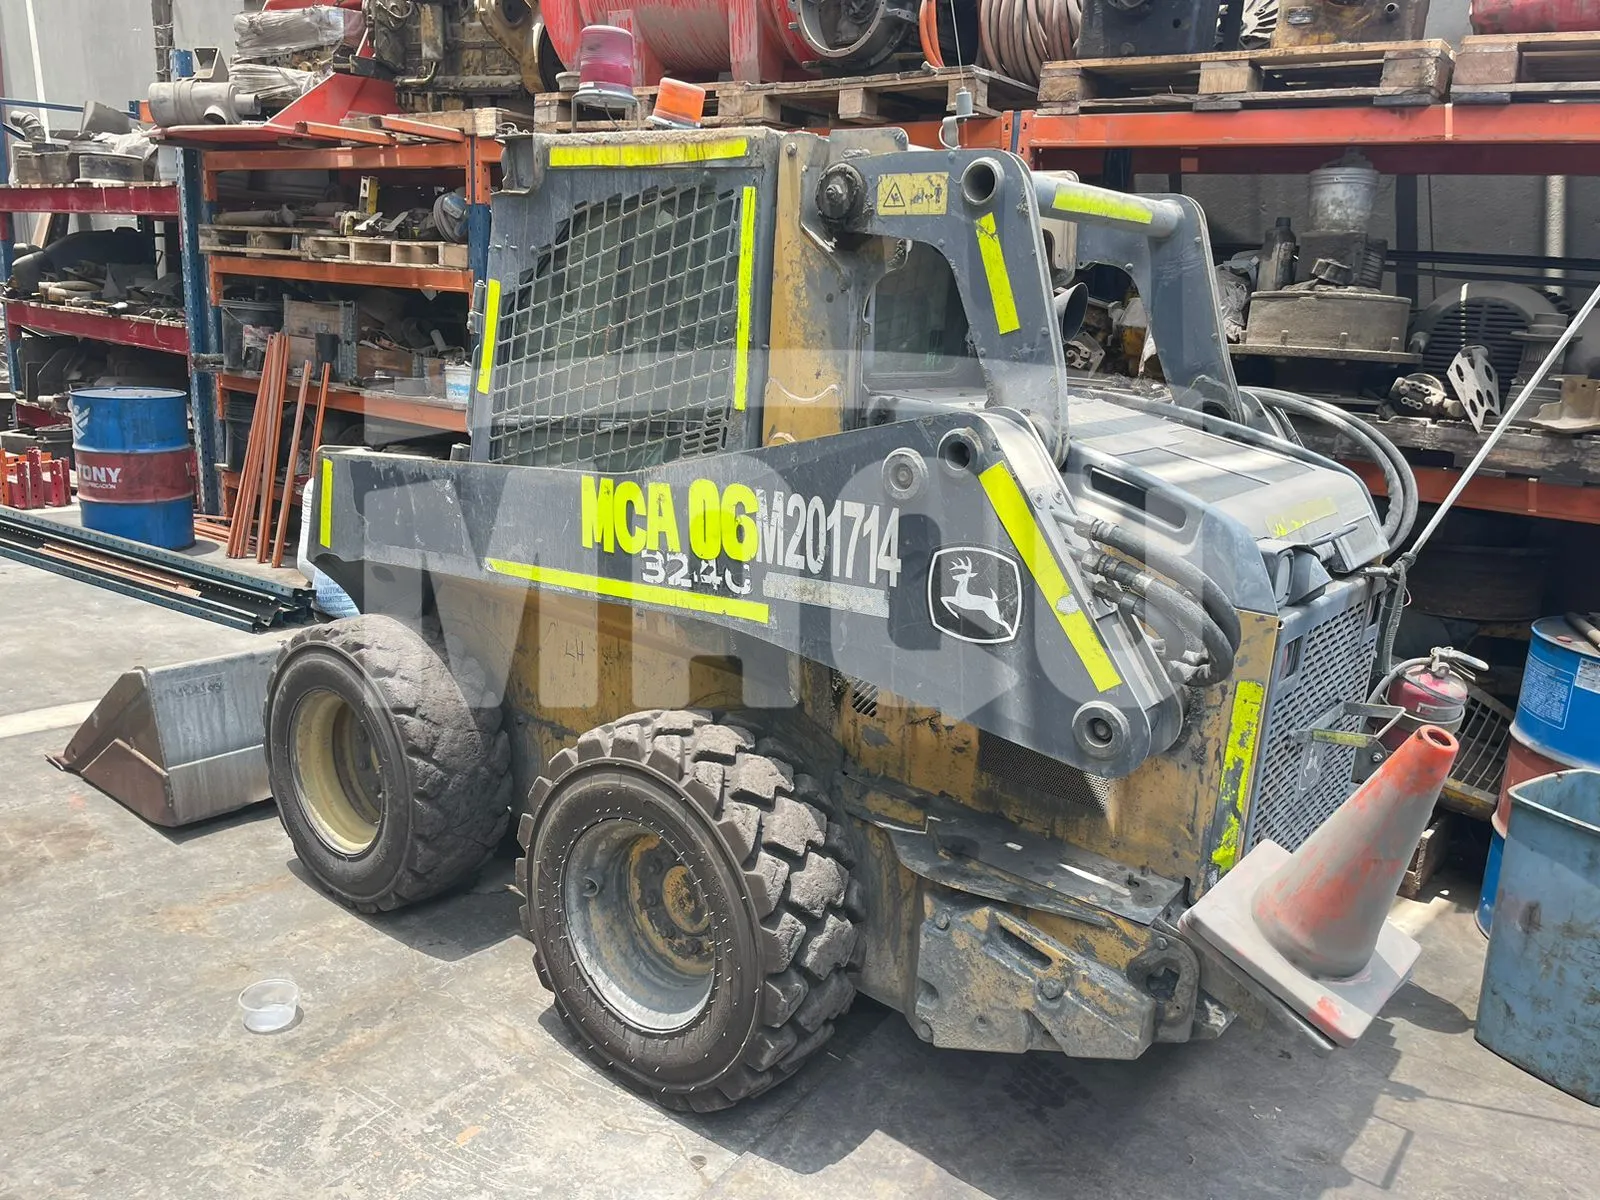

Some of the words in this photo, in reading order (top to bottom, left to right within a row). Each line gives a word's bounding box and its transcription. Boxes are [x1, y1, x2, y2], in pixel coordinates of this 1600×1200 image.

[581, 474, 681, 555] MCA
[688, 478, 759, 572] 06
[755, 488, 902, 588] M201714
